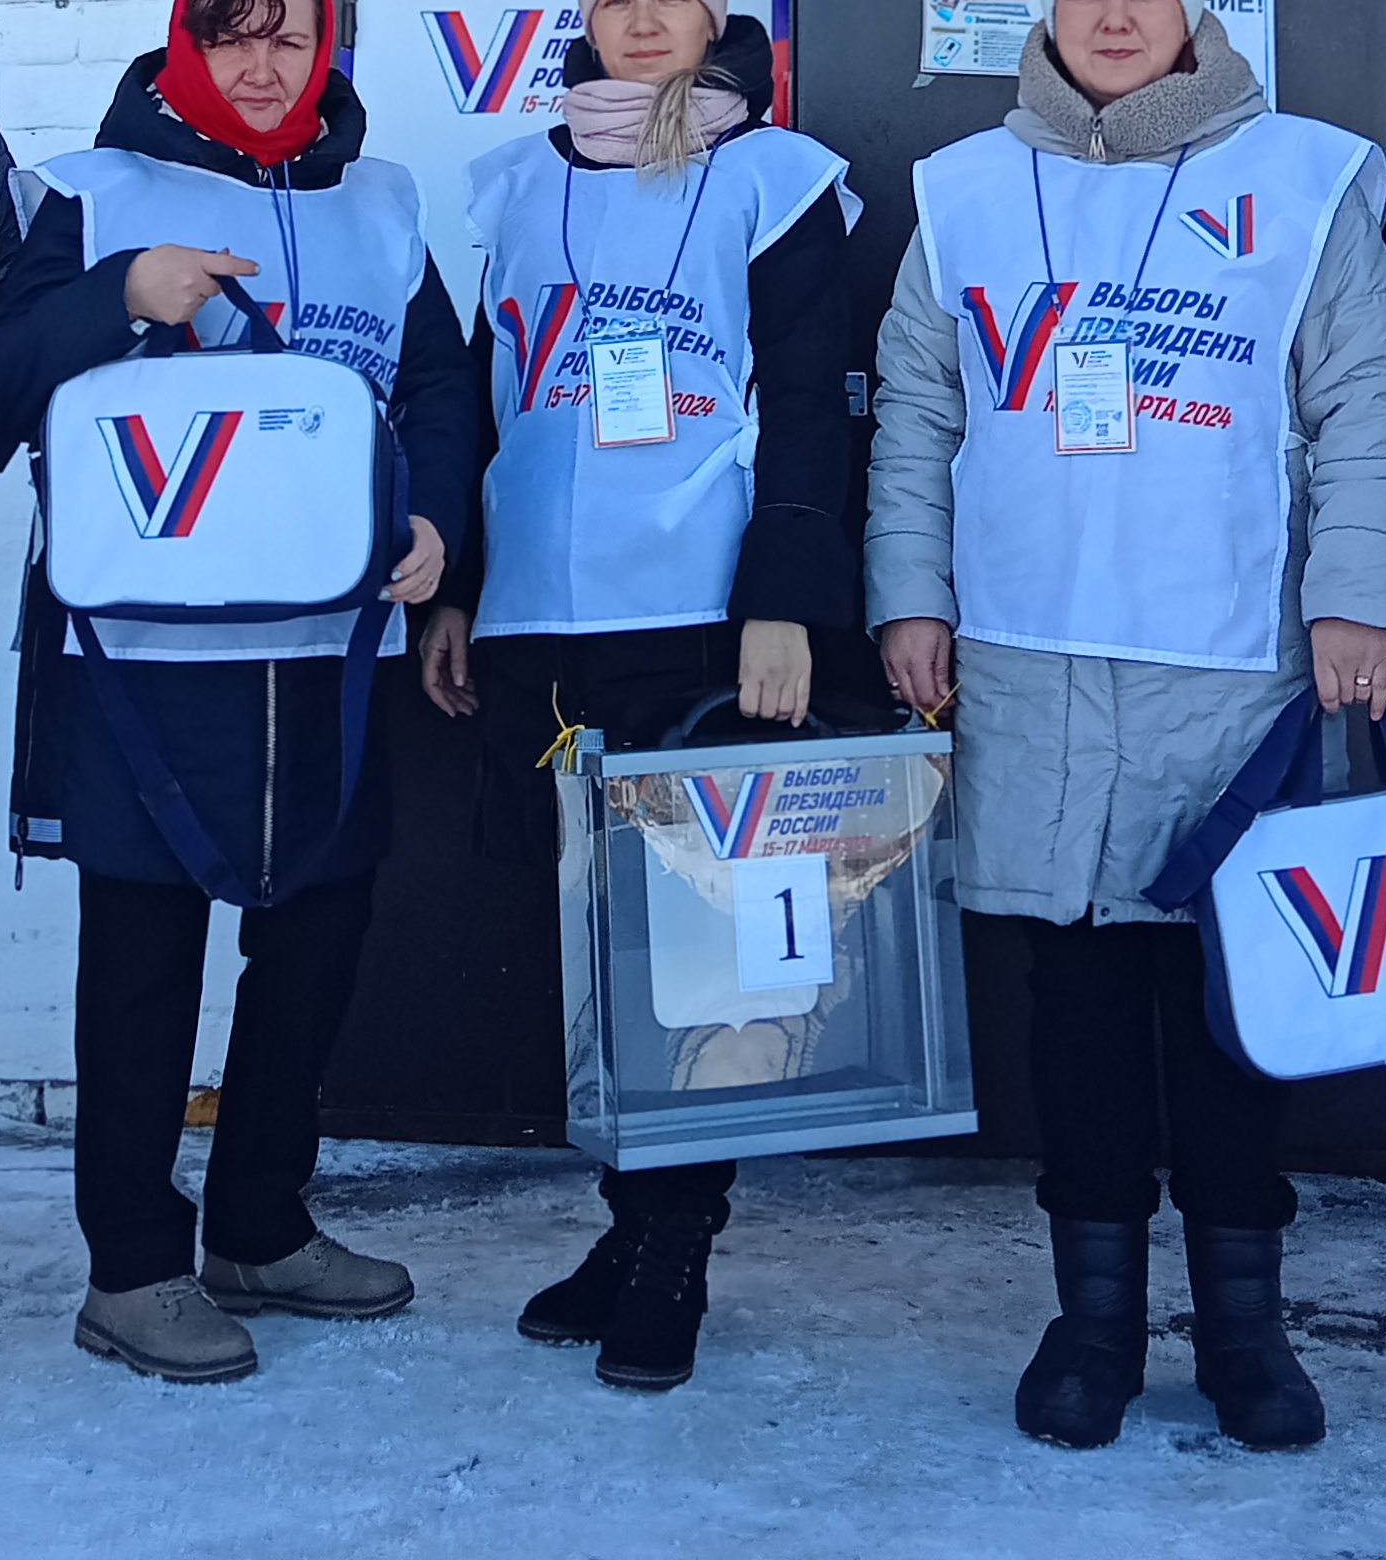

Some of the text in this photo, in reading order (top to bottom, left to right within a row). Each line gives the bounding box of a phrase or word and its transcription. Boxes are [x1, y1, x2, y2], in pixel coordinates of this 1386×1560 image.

[586, 281, 705, 324] ВЫБОРЫ
[1087, 281, 1228, 322] ВЫБОРЫ
[299, 302, 397, 346] ВЫБОРЫ
[1069, 316, 1256, 366] ПРЕЗИДЕНТА
[672, 391, 717, 417] 2024
[1134, 394, 1178, 422] РТА
[1178, 400, 1233, 430] 2024
[782, 766, 861, 789] ВЫБОРЫ
[774, 788, 886, 813] ПРЕЗИДЕНТА
[767, 814, 840, 838] РОССИИ
[774, 887, 805, 963] 1
